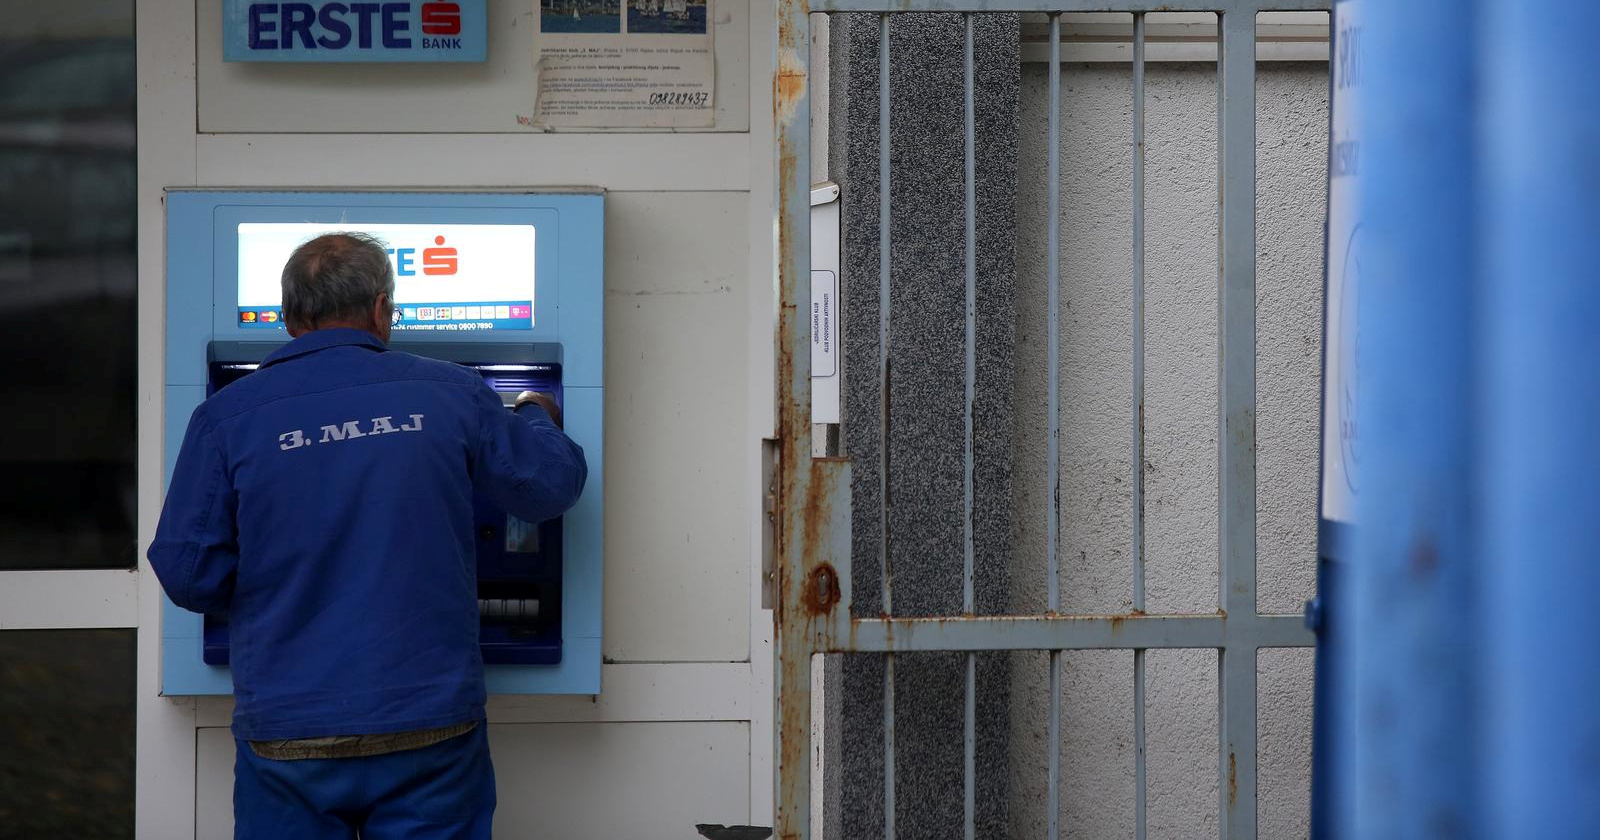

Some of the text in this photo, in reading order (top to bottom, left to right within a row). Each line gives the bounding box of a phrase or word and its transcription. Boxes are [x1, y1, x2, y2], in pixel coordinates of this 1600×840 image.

[247, 3, 412, 50] ERSTE
[422, 37, 462, 49] BANK
[649, 91, 709, 106] 098289437
[278, 413, 424, 451] 3. MAJ
